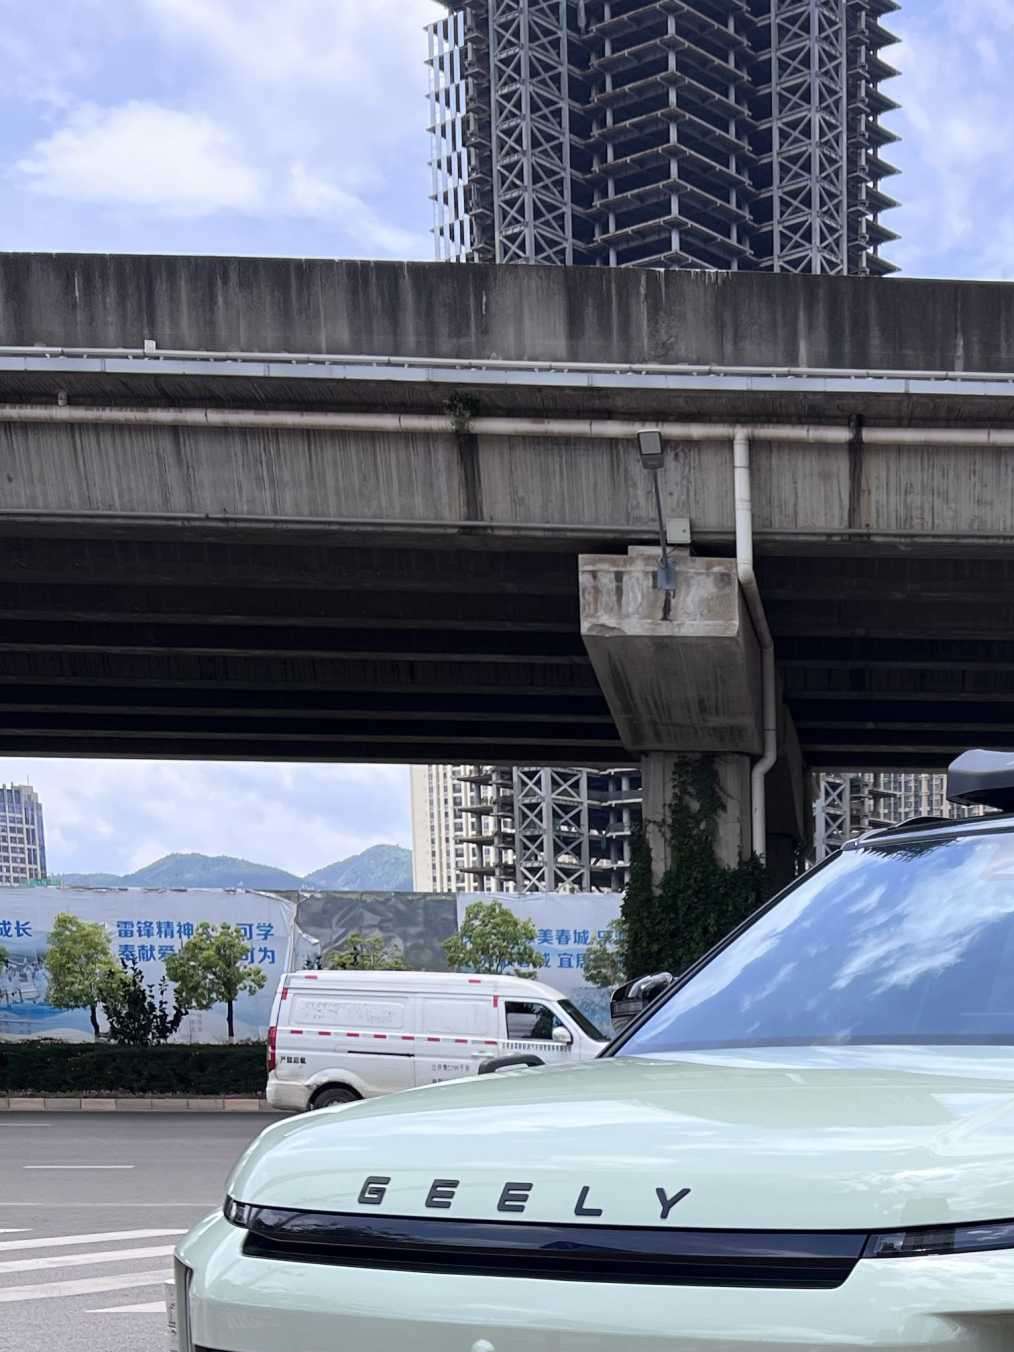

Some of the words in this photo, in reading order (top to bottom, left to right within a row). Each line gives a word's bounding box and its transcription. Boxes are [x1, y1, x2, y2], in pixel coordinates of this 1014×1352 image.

[529, 928, 590, 946] 美春城
[358, 1175, 691, 1220] GEELY
